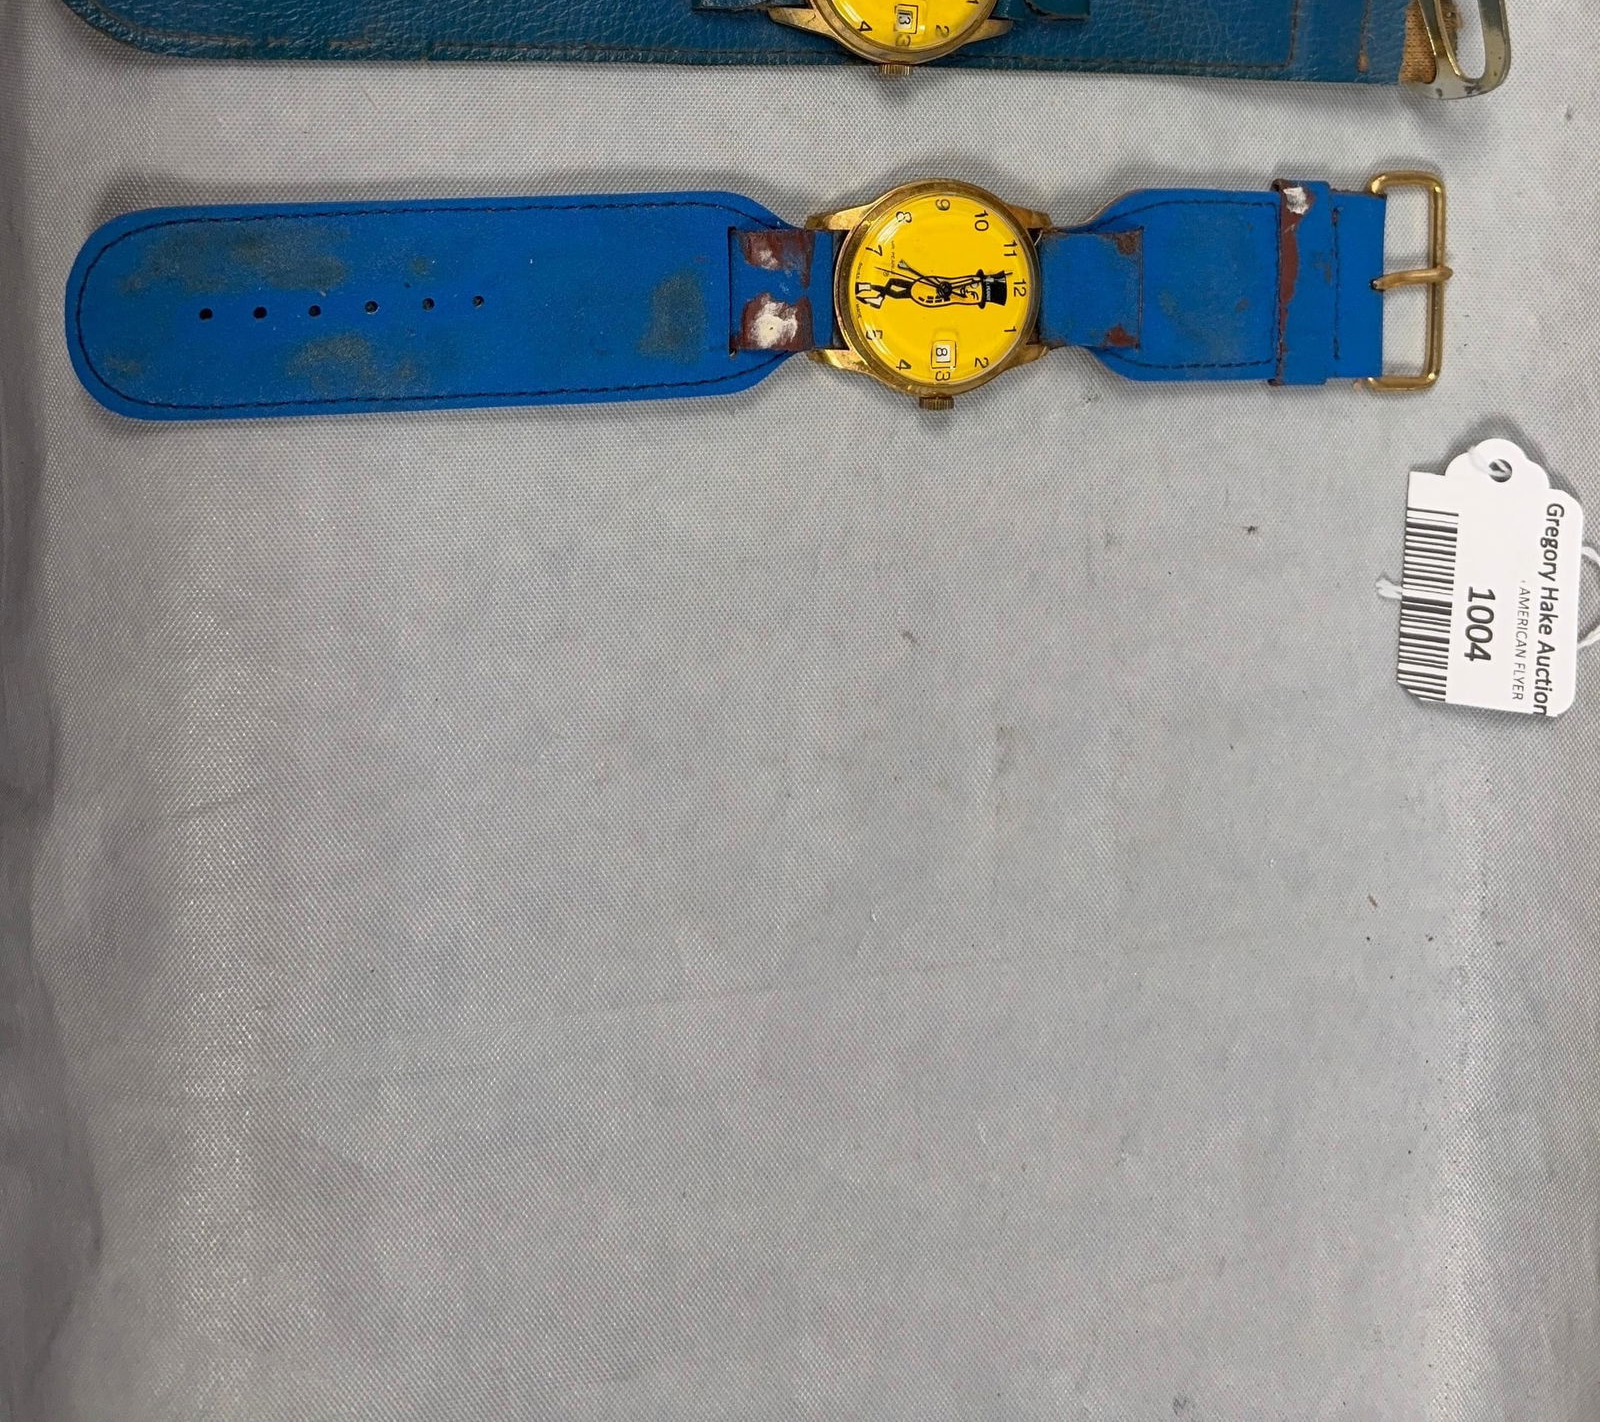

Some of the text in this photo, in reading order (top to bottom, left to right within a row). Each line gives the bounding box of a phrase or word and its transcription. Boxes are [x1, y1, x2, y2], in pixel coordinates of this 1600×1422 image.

[857, 21, 872, 32] 4
[935, 198, 950, 211] 9
[975, 210, 988, 231] 10
[865, 244, 882, 256] 7
[1004, 240, 1017, 257] 11
[1013, 279, 1026, 297] 12
[936, 347, 948, 356] 8
[896, 360, 911, 371] 4
[975, 357, 988, 368] 2
[935, 371, 950, 382] 3
[1533, 503, 1565, 716] Gregory Hake Auction
[1464, 586, 1496, 661] 1004
[1512, 586, 1531, 700] AMERICAN FLYER
